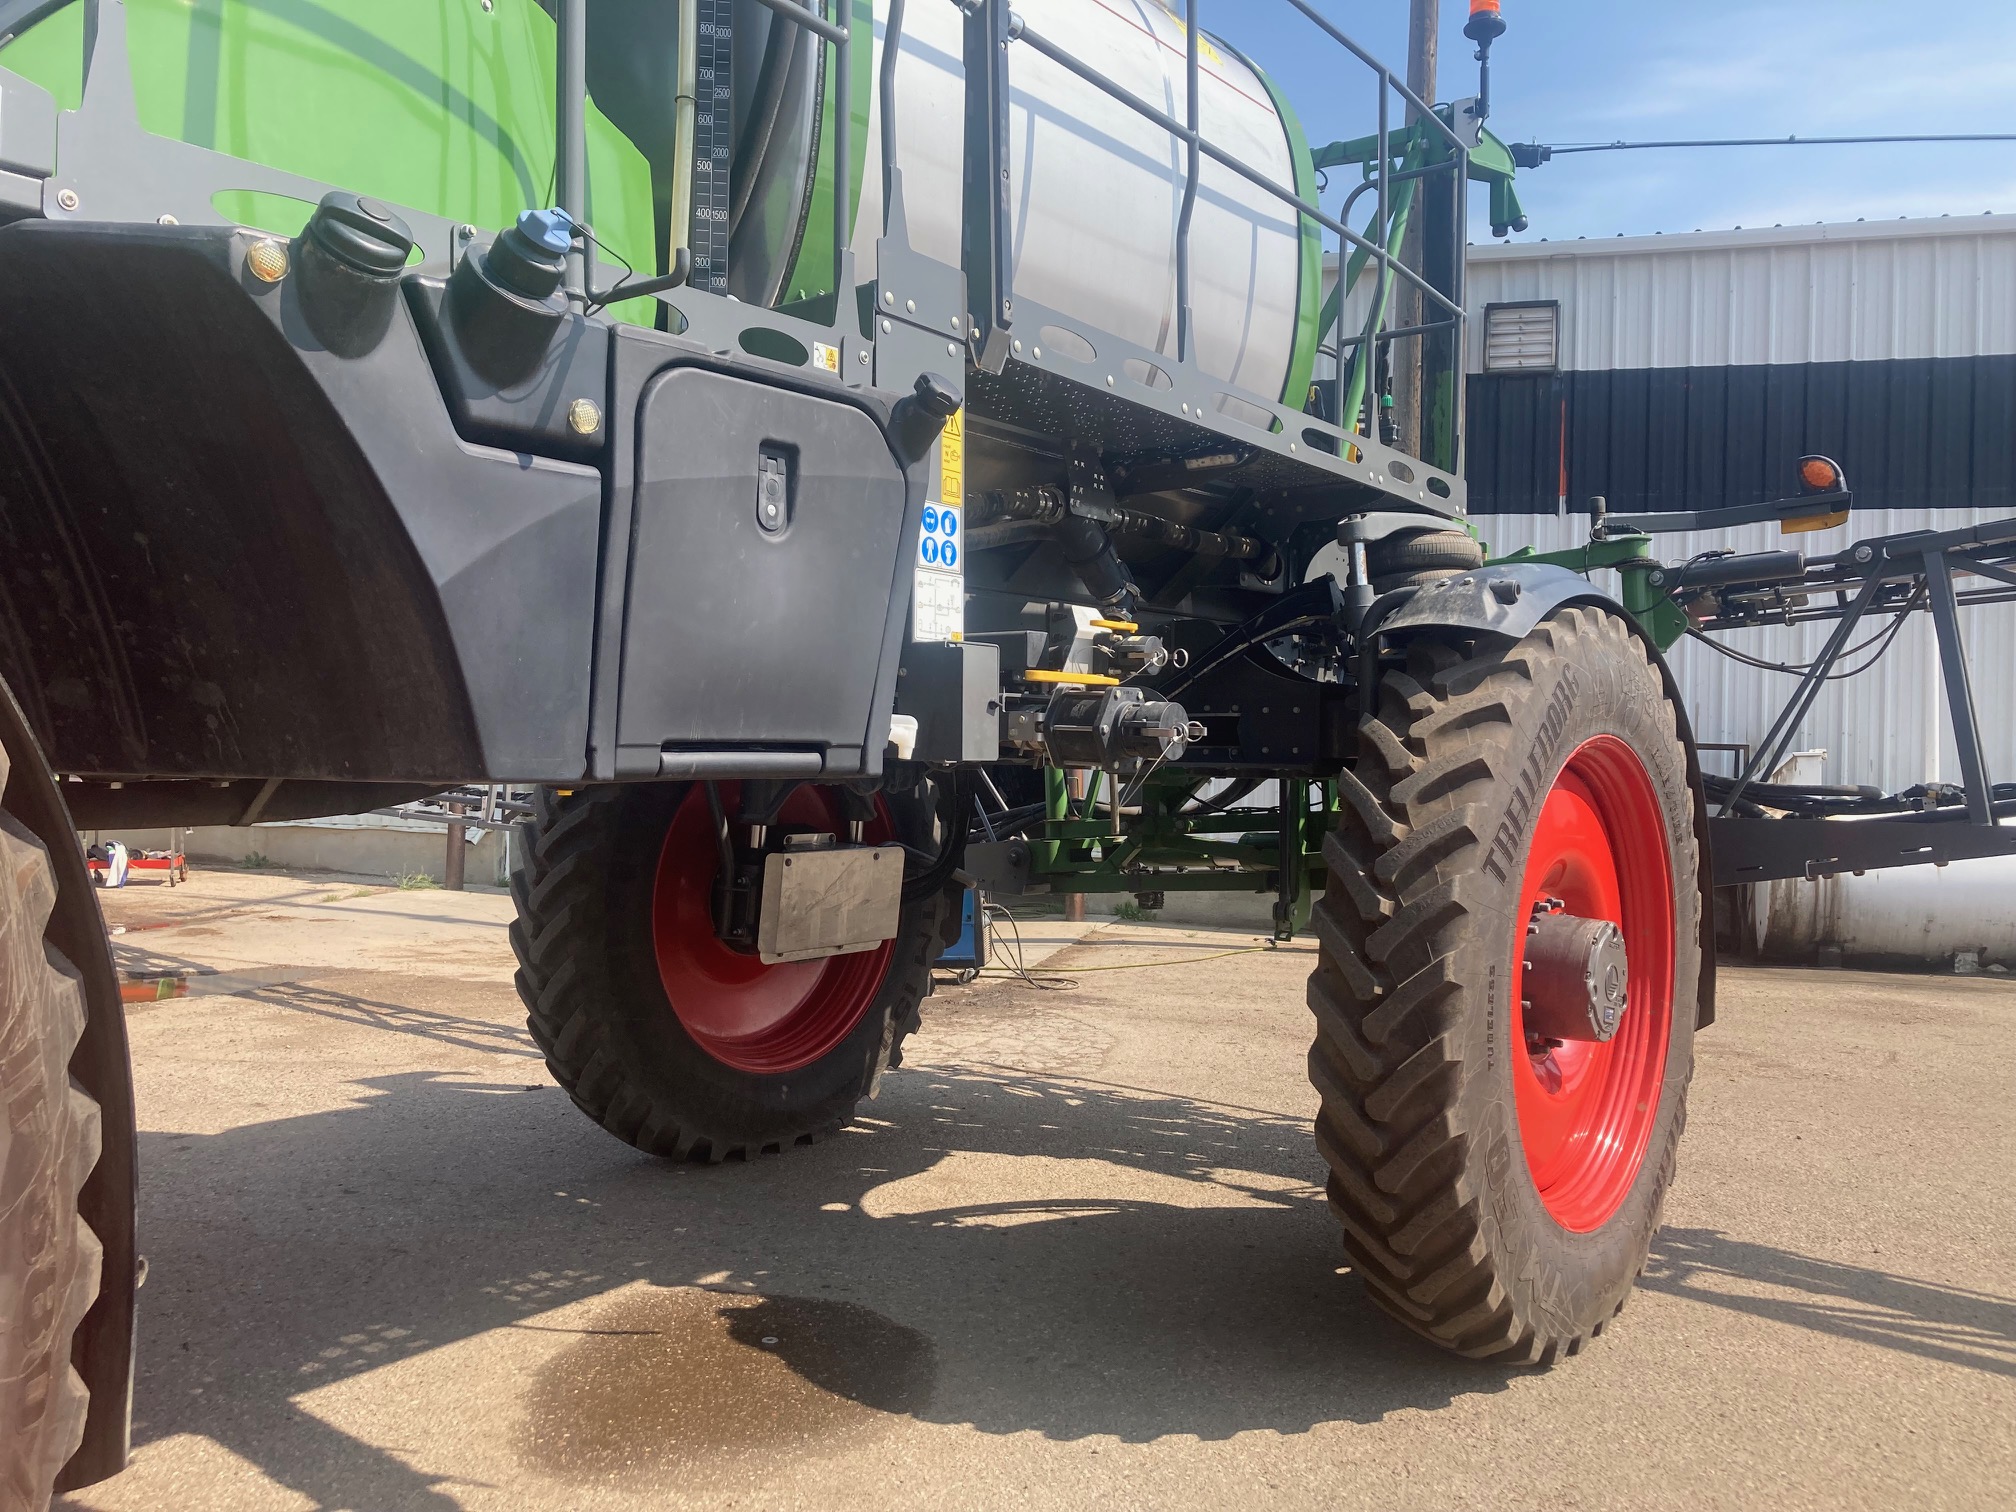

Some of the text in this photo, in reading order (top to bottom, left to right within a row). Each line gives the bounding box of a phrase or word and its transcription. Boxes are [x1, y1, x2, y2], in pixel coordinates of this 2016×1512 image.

[700, 23, 715, 34] 800
[715, 28, 731, 38] 3000
[699, 68, 714, 79] 700
[714, 88, 730, 98] 2500
[698, 114, 713, 124] 600
[712, 147, 729, 157] 2000
[696, 160, 711, 171] 500
[695, 208, 711, 218] 400
[711, 210, 727, 220] 1500
[694, 257, 710, 267] 300
[710, 276, 727, 287] 1000
[1480, 661, 1580, 887] TRELLEBORG
[1487, 964, 1496, 1073] TUBELESS
